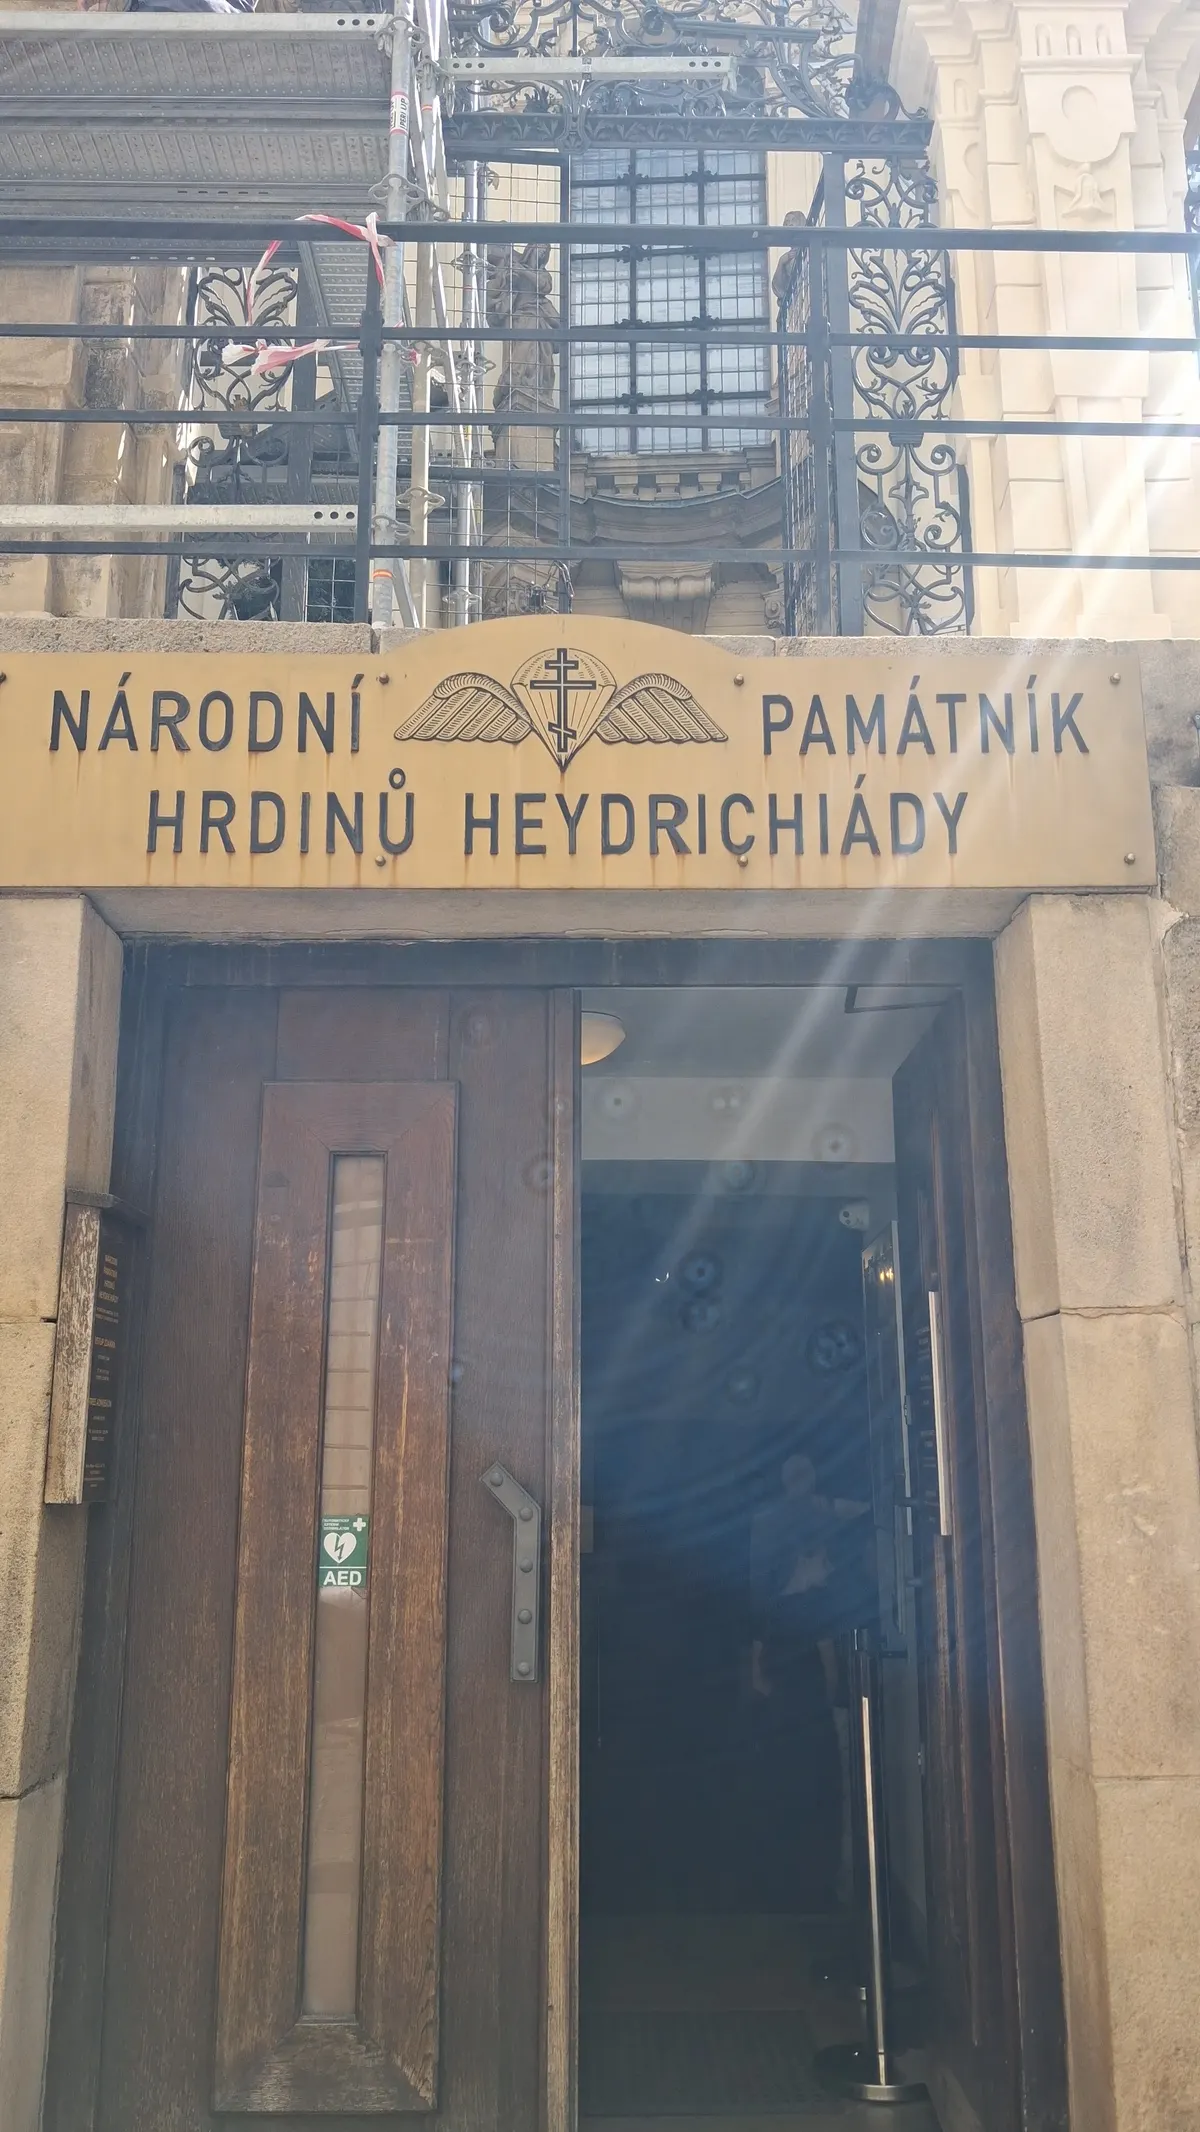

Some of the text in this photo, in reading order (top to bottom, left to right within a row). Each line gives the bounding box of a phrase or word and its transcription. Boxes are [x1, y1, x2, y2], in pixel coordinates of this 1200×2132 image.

[49, 672, 1091, 755] NÁRODNÍ PAMÁTNÍK
[146, 767, 969, 856] HRDINŮ HEYDRICHIÁDY
[323, 1570, 362, 1586] AED
